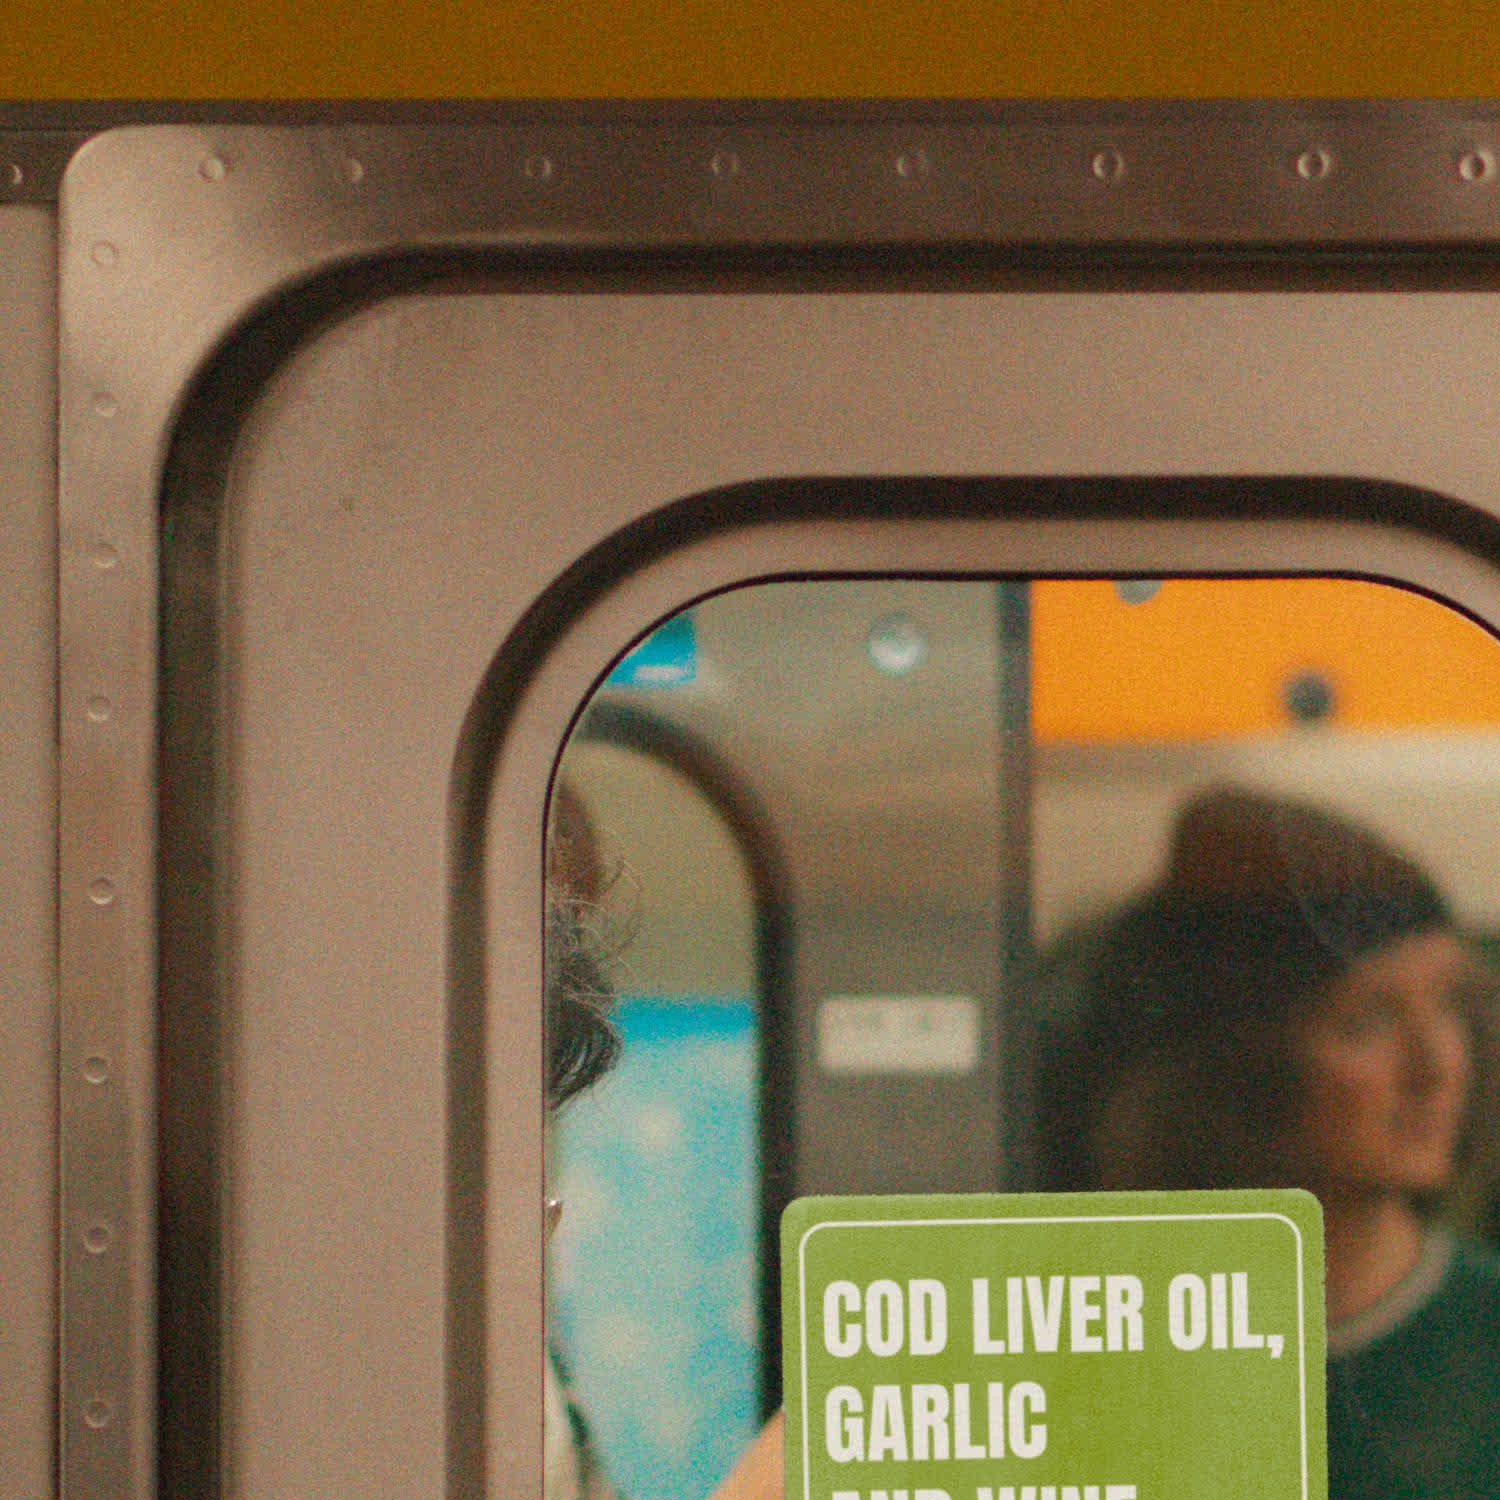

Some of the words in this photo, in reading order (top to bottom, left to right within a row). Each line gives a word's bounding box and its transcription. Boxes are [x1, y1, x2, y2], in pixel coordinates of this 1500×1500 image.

[823, 1278, 949, 1358] COD
[972, 1274, 1144, 1355] LIVER
[1168, 1271, 1285, 1359] OIL,
[825, 1381, 1048, 1463] GARLIC
